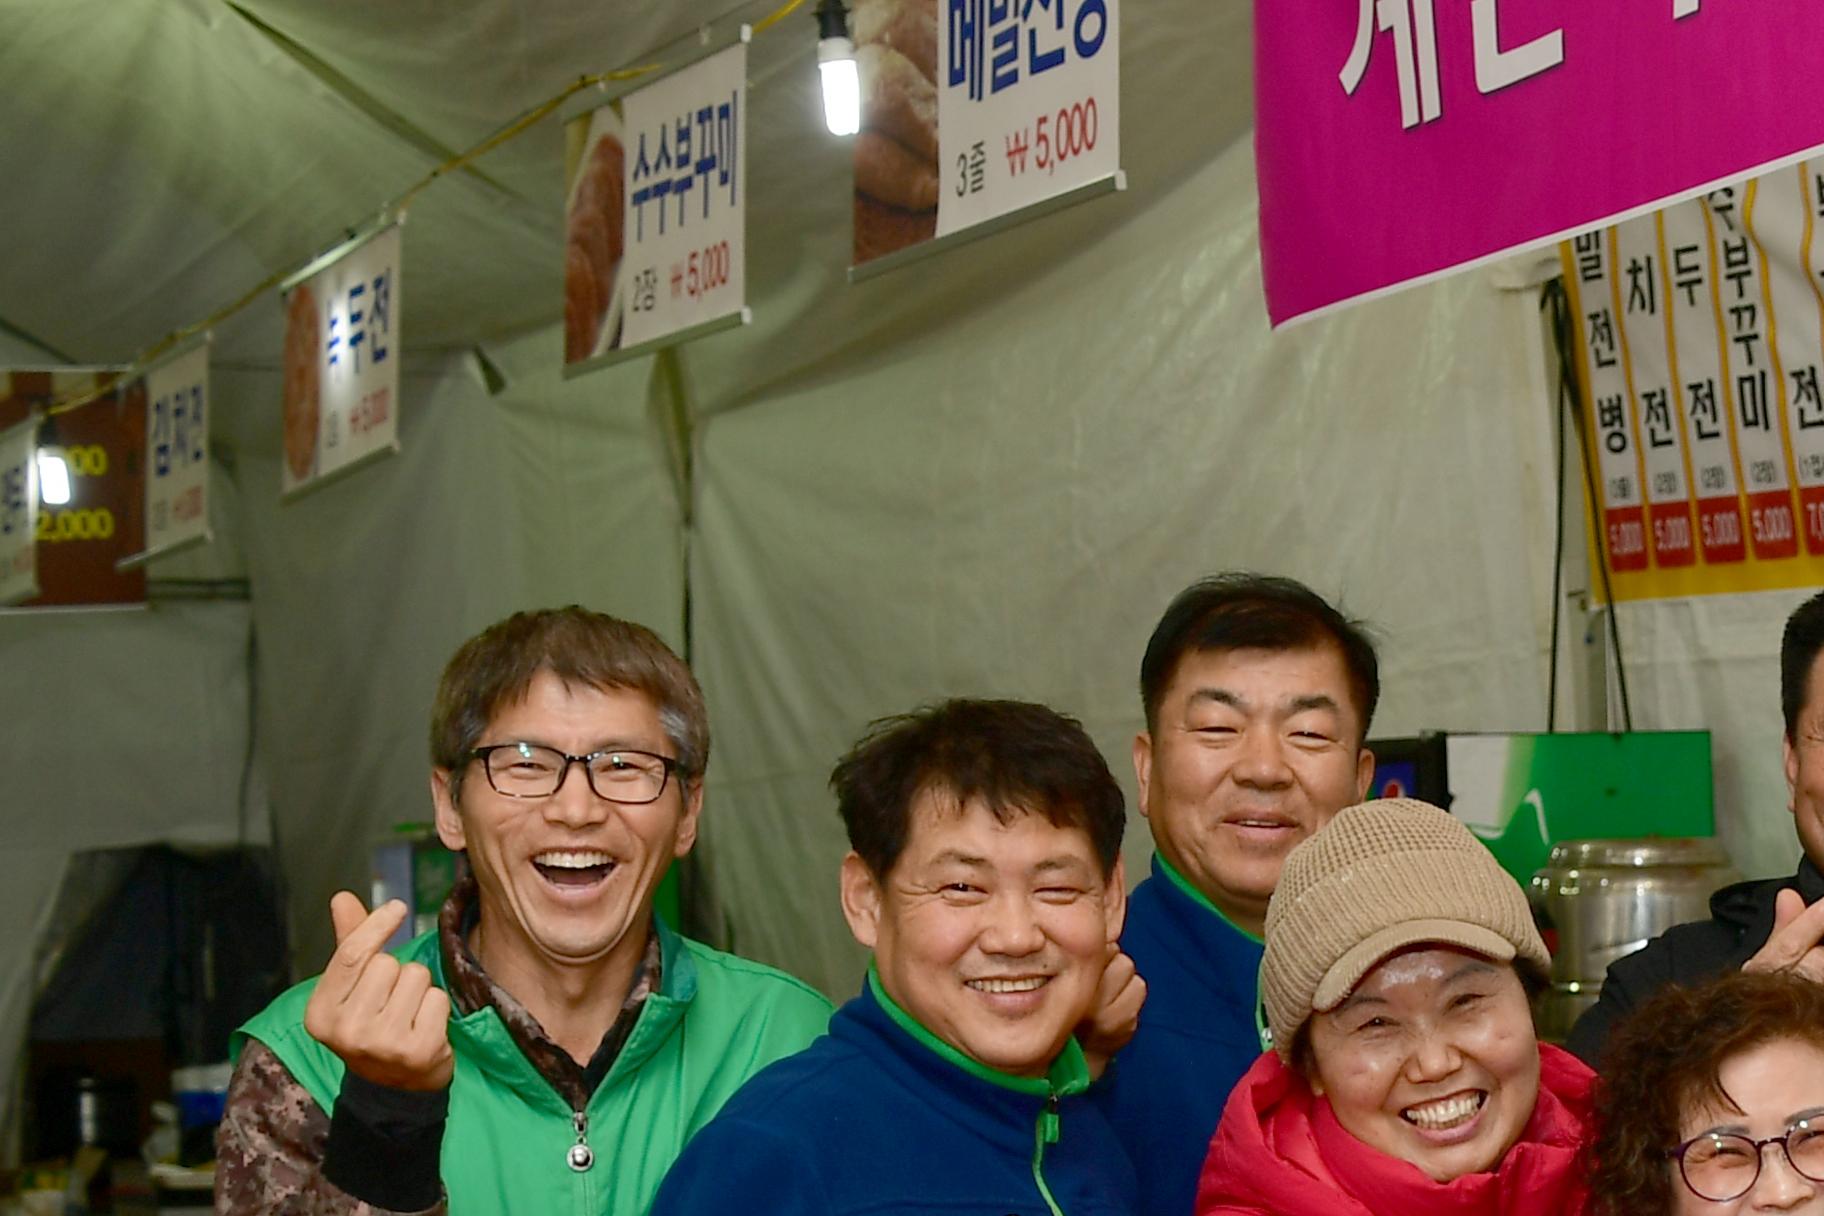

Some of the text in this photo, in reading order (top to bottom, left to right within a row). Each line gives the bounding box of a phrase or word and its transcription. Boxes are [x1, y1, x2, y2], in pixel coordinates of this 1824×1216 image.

[632, 90, 737, 242] 수수부꾸미
[956, 140, 986, 197] 3줄
[1626, 255, 1674, 448] 치전
[1673, 245, 1720, 440] 두전
